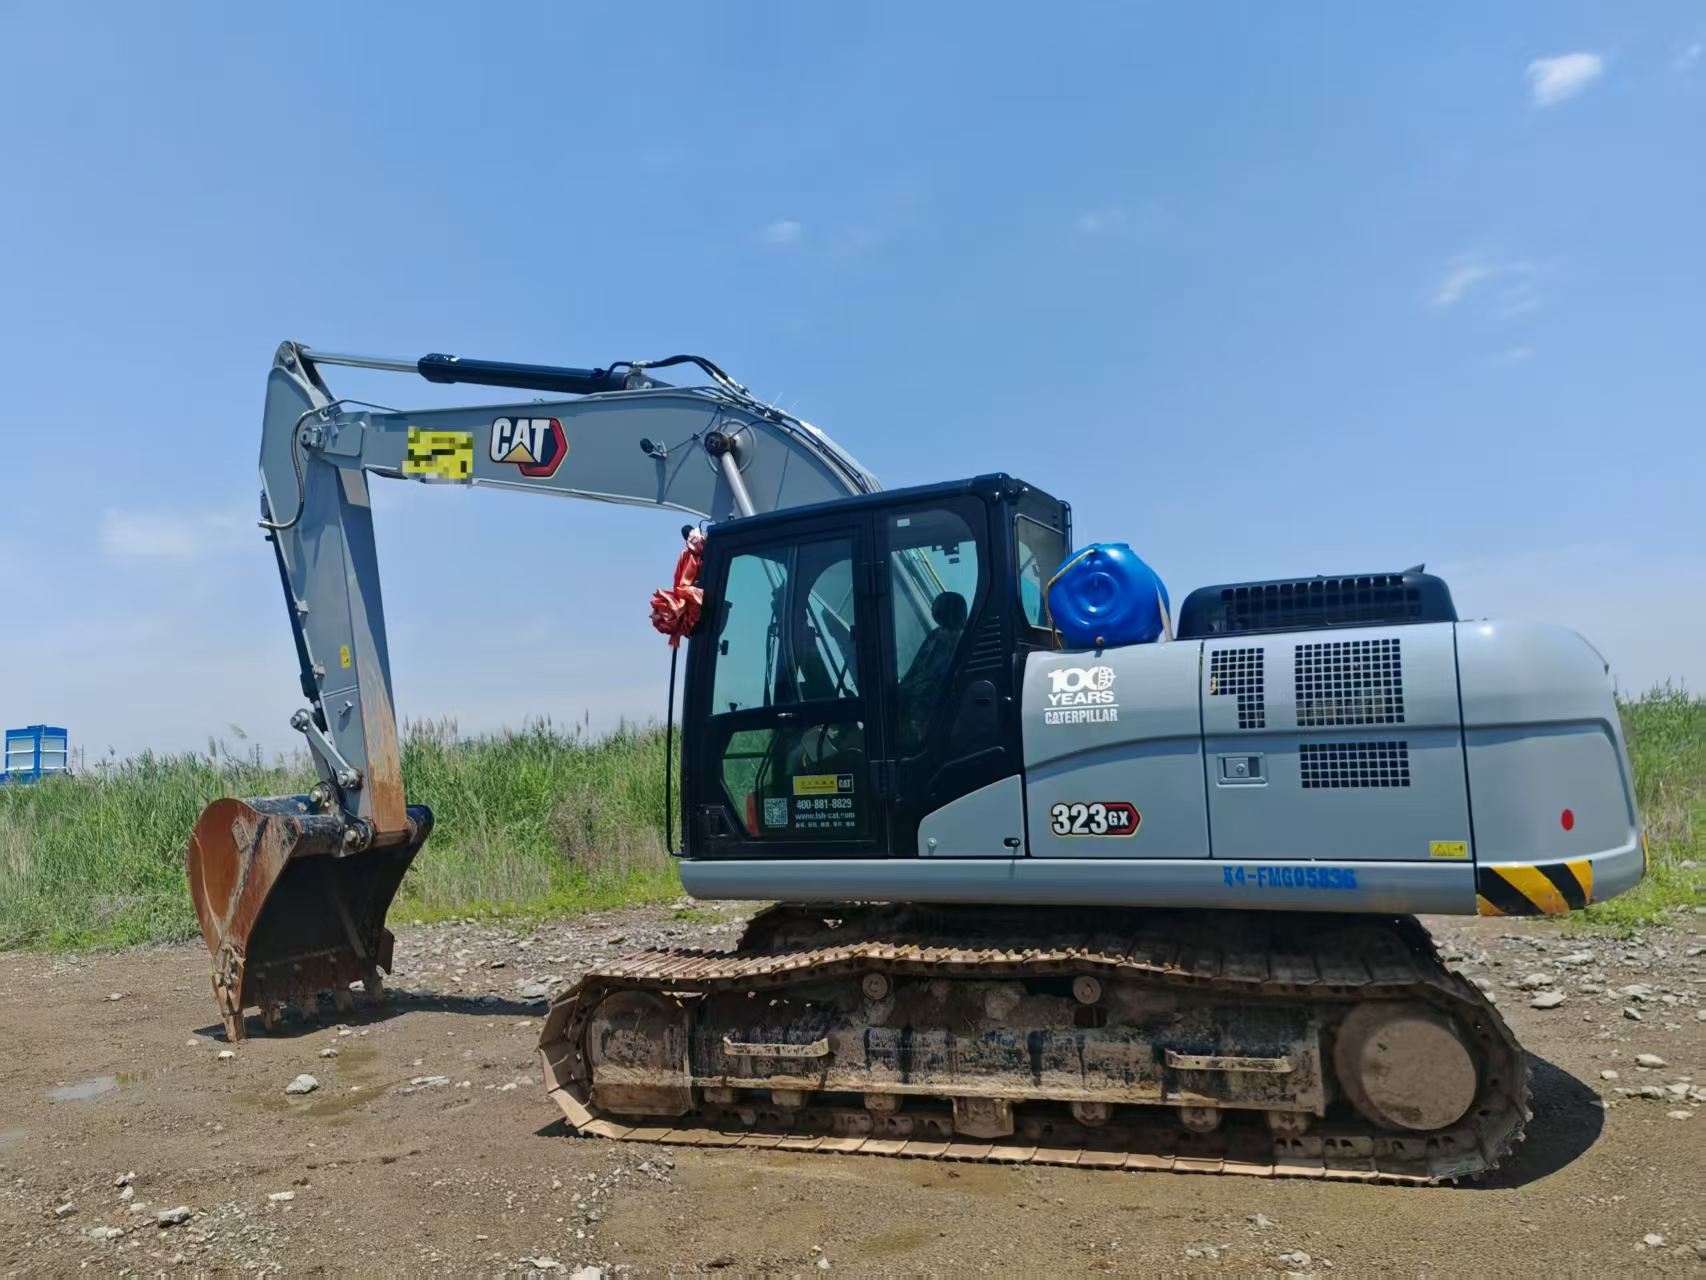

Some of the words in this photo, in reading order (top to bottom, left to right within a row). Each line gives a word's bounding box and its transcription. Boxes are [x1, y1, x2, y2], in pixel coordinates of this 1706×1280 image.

[491, 417, 550, 463] CAT
[1048, 666, 1115, 693] 100
[1048, 691, 1114, 706] YEARS
[1045, 708, 1118, 724] CATERPILLAR
[838, 779, 851, 788] CAT
[796, 798, 852, 809] 400-881-8829
